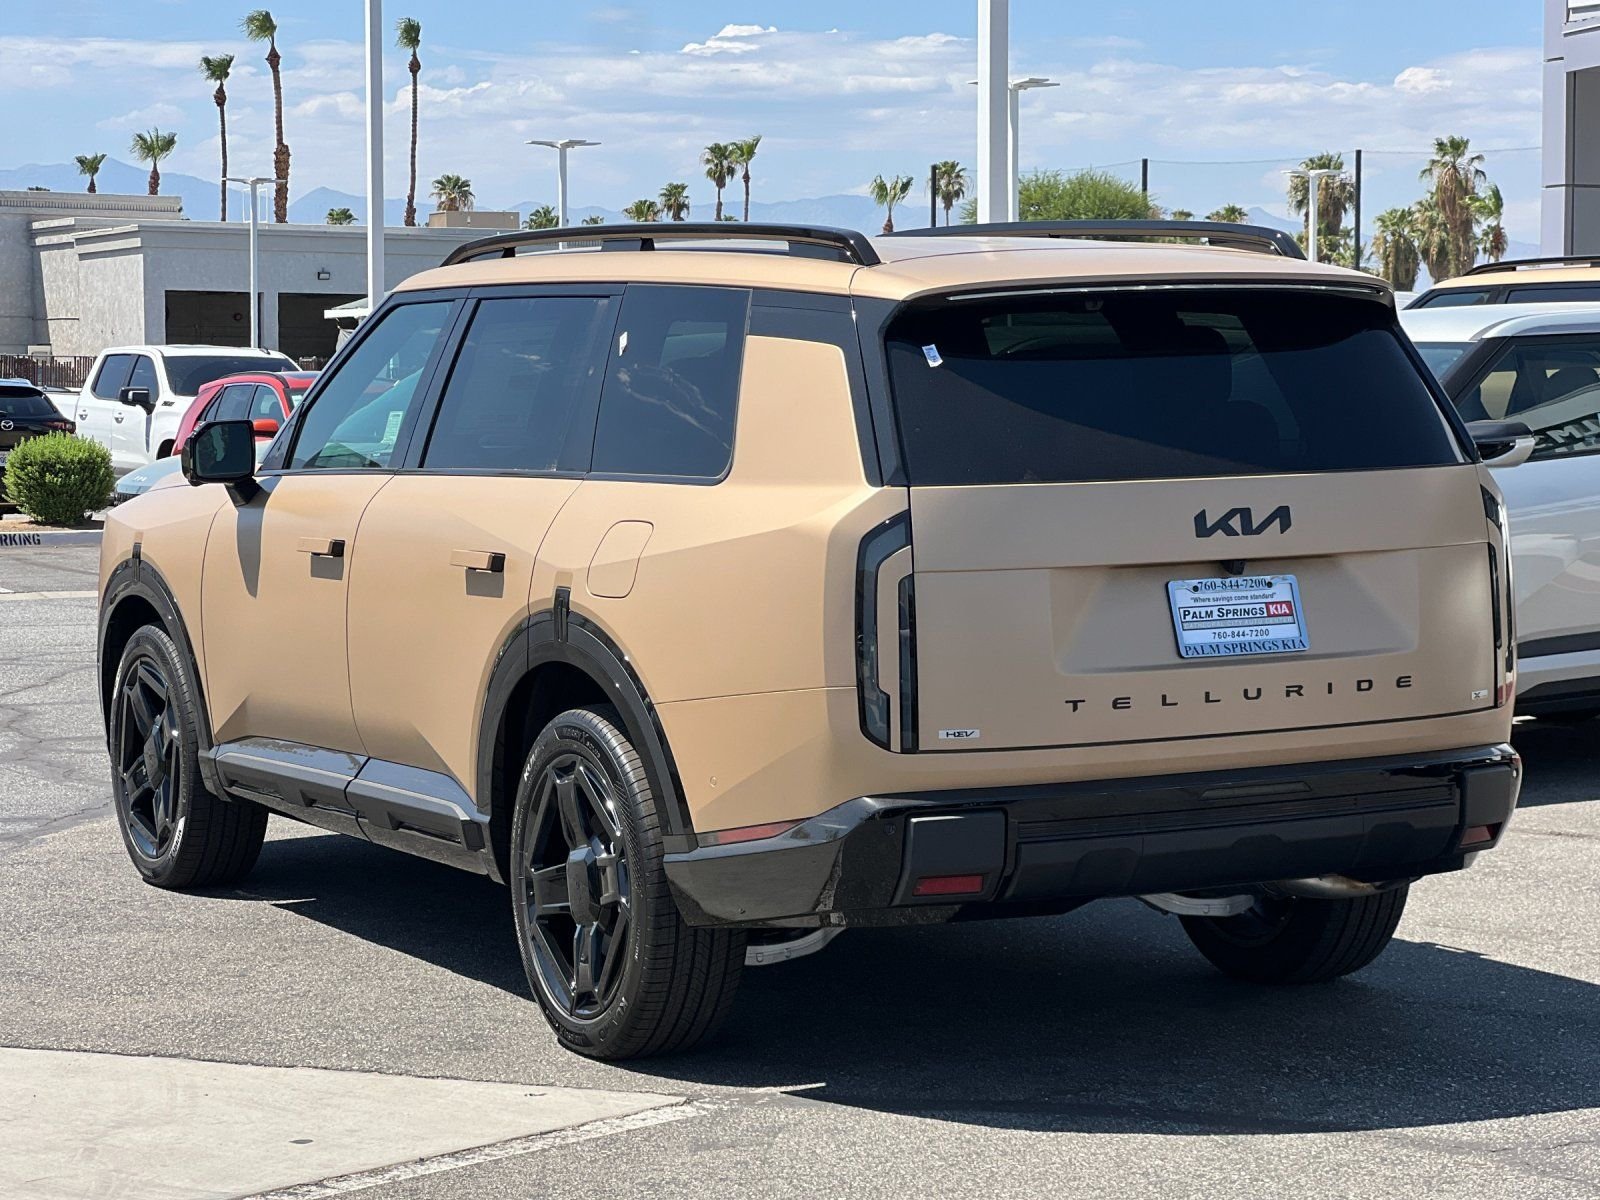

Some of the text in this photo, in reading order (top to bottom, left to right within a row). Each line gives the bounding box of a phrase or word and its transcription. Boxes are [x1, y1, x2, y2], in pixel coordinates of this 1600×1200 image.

[1197, 578, 1267, 591] 760-844-7200
[1182, 603, 1290, 620] PALM SPRINGS KIA
[1212, 628, 1270, 639] 760-844-7200
[1184, 638, 1307, 656] PALM SPRINGS KIA
[1065, 675, 1412, 713] TELLURIDE
[945, 730, 975, 738] HEV
